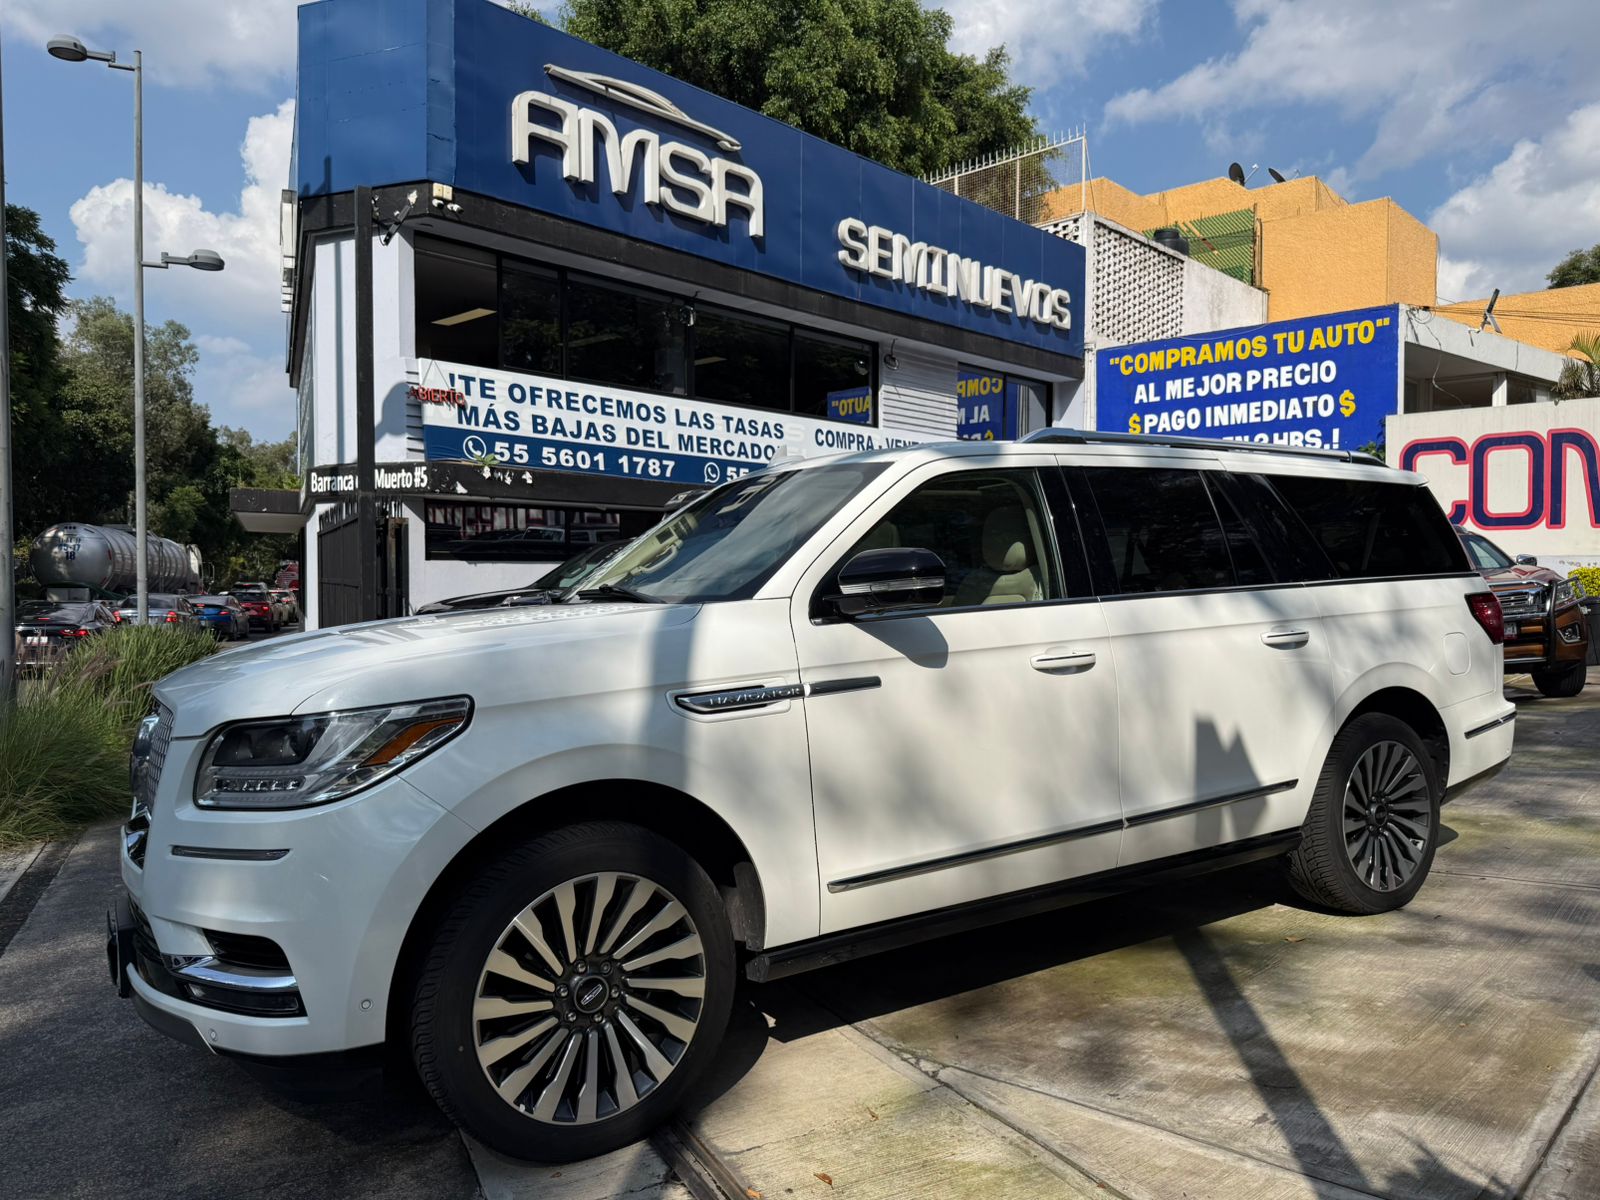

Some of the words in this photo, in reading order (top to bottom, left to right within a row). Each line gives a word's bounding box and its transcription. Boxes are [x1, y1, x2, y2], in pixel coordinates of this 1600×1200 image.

[512, 90, 764, 237] AMSA
[838, 217, 1071, 330] SEMINUEVOS
[1109, 335, 1267, 376] "COMPRAMOS
[1273, 329, 1304, 355] TU
[1309, 317, 1391, 350] AUTO"
[407, 384, 466, 406] ABIERTO
[1134, 383, 1160, 405] AL
[1165, 370, 1242, 401] MEJOR
[1250, 360, 1337, 389] PRECIO
[457, 403, 520, 432] MÁS
[532, 413, 617, 444] BAJAS
[626, 426, 670, 450] DEL
[508, 383, 667, 424] OFRECEMOS
[675, 408, 715, 431] LAS
[722, 415, 784, 440] TASAS
[1205, 394, 1335, 428] INMEDIATO
[1339, 389, 1356, 418] $
[494, 441, 529, 463] 55
[542, 446, 605, 471] 5601
[618, 455, 676, 478] 1787
[815, 428, 875, 450] COMPRA
[311, 472, 354, 493] Barranca
[374, 467, 413, 490] Muerto
